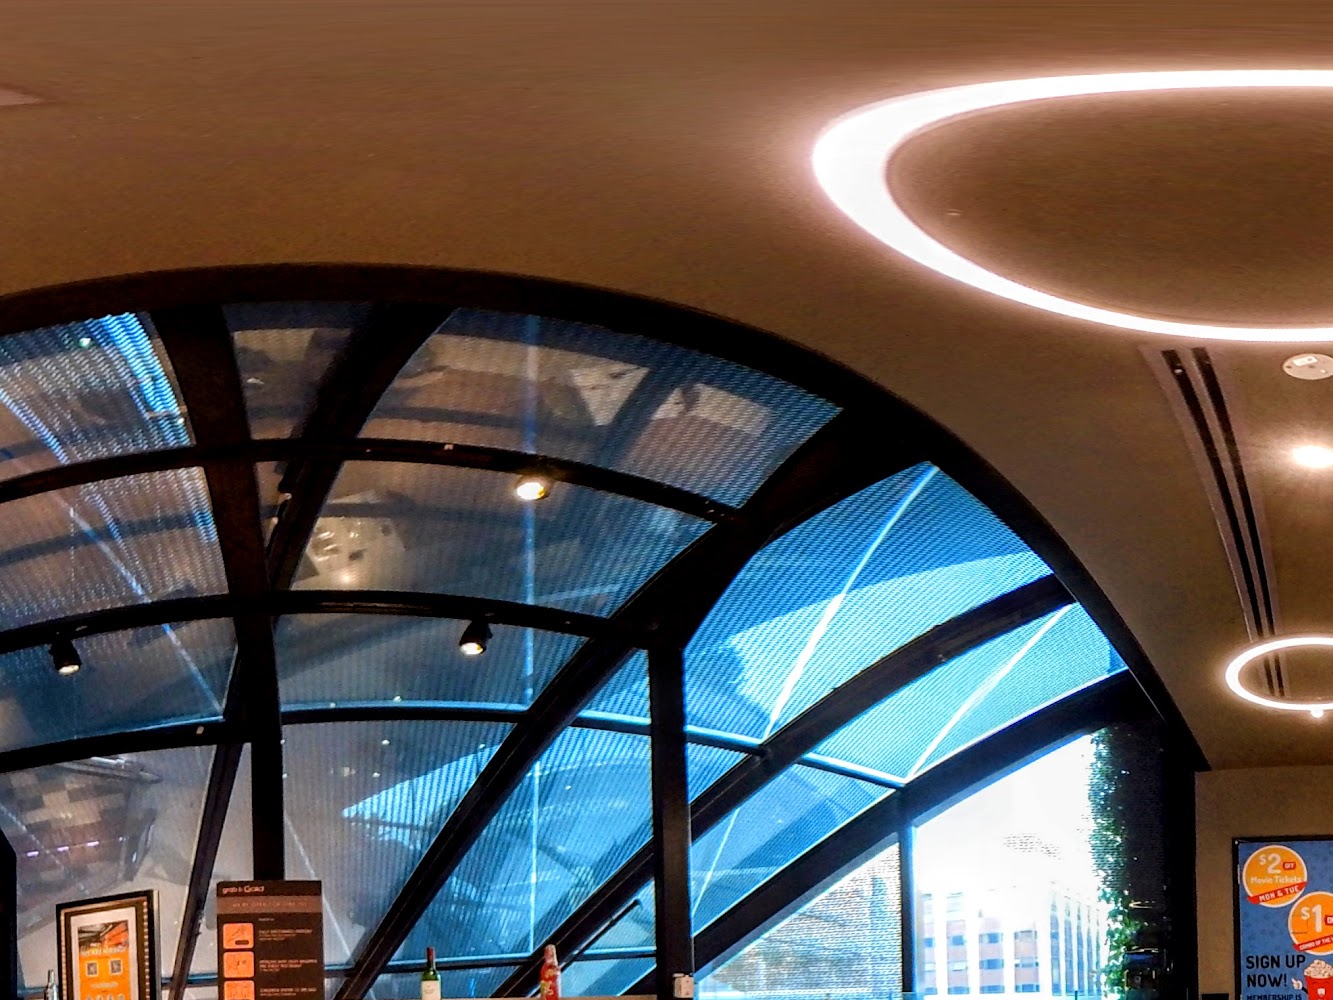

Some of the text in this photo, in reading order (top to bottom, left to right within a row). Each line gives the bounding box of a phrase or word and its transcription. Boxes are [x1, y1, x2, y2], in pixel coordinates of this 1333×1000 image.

[1259, 853, 1281, 874] $2
[1250, 875, 1302, 884] Movie Tickets
[243, 885, 265, 893] Gold
[1258, 891, 1276, 903] MON
[1284, 885, 1300, 895] TUE
[1300, 904, 1323, 933] $1
[1246, 954, 1306, 969] SIGN UP
[1247, 974, 1287, 988] NOW!
